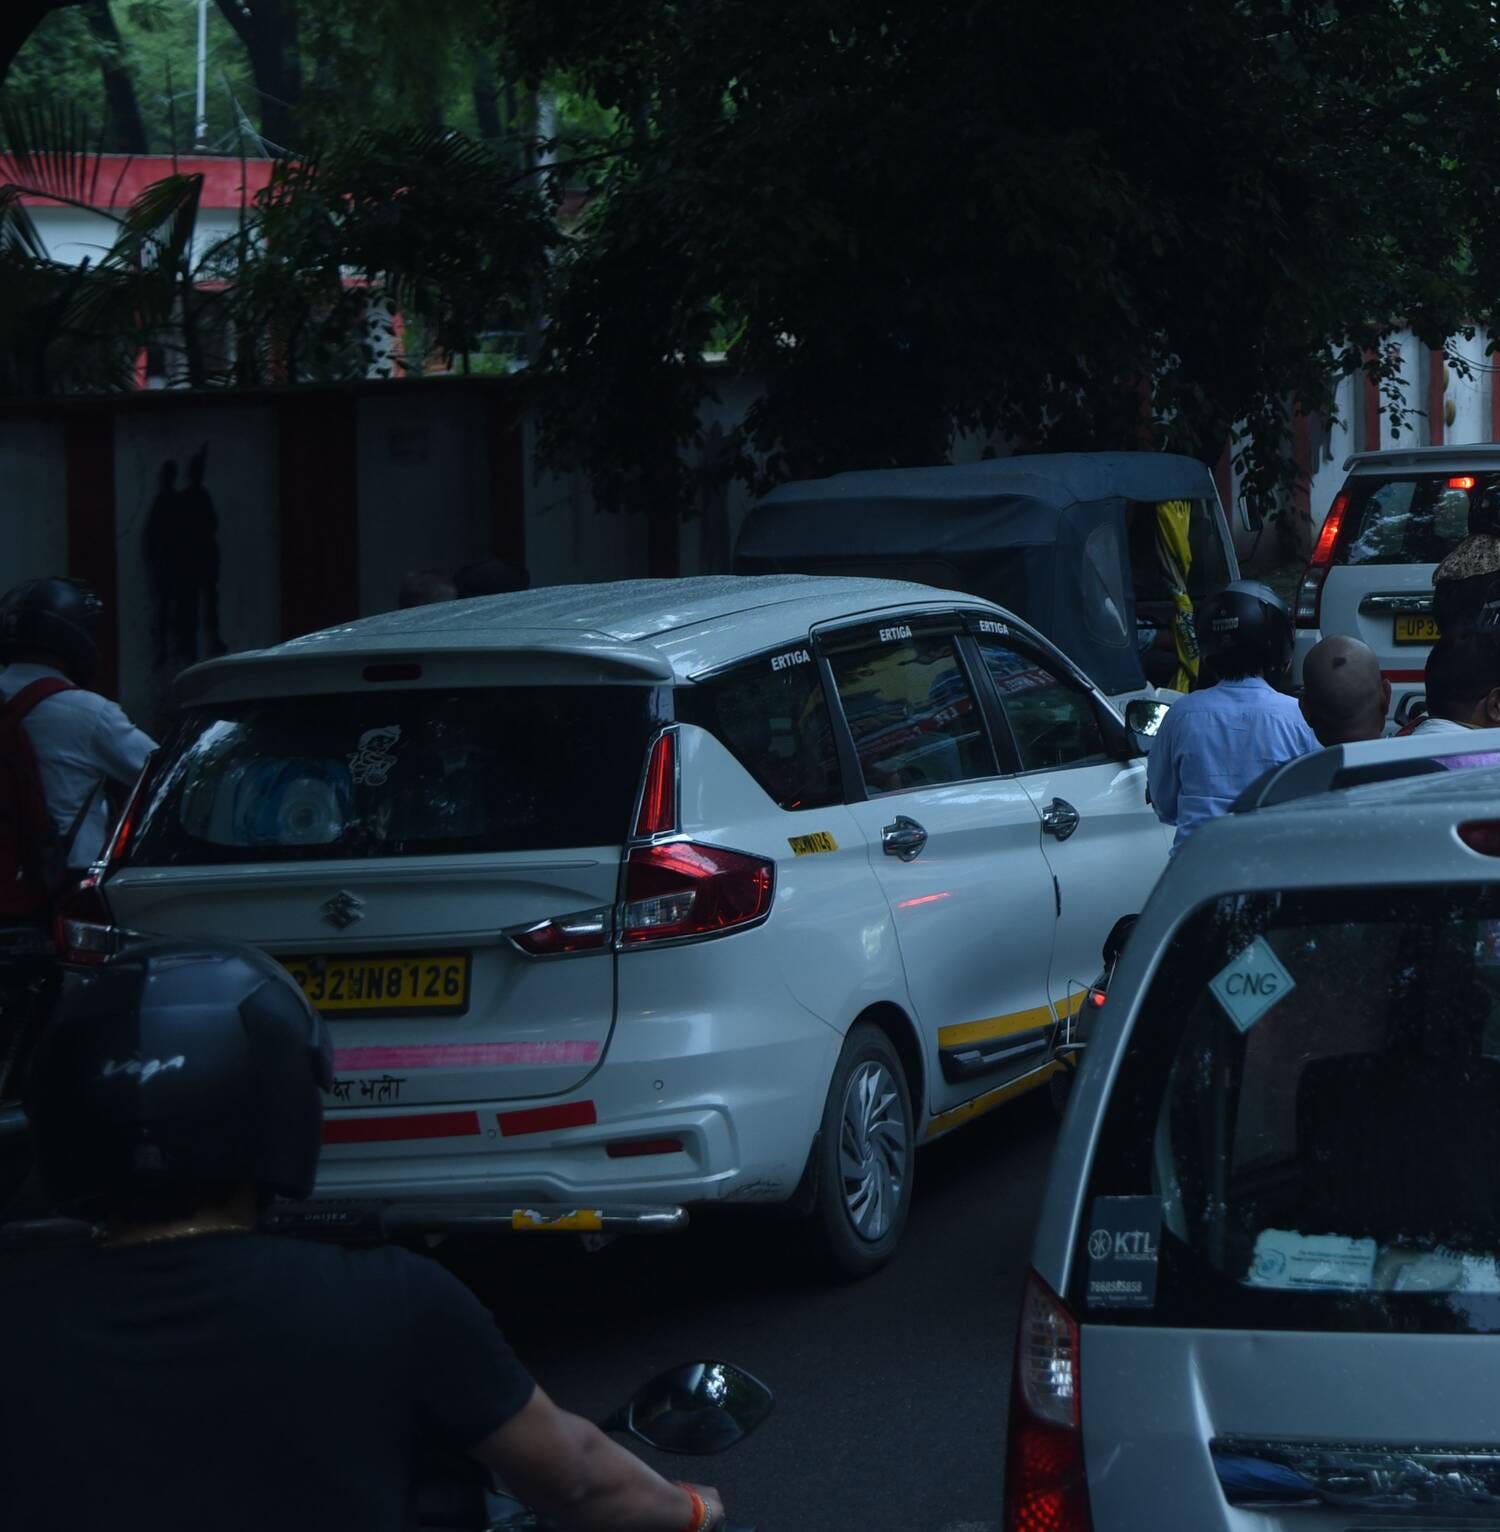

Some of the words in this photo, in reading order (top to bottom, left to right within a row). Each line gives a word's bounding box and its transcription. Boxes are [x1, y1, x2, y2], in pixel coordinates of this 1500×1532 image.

[879, 625, 912, 642] ERTIGA
[979, 620, 1009, 635] ERTIGA
[770, 649, 811, 672] ERTIGA
[1225, 973, 1278, 996] CNG
[1114, 1231, 1156, 1253] KTL
